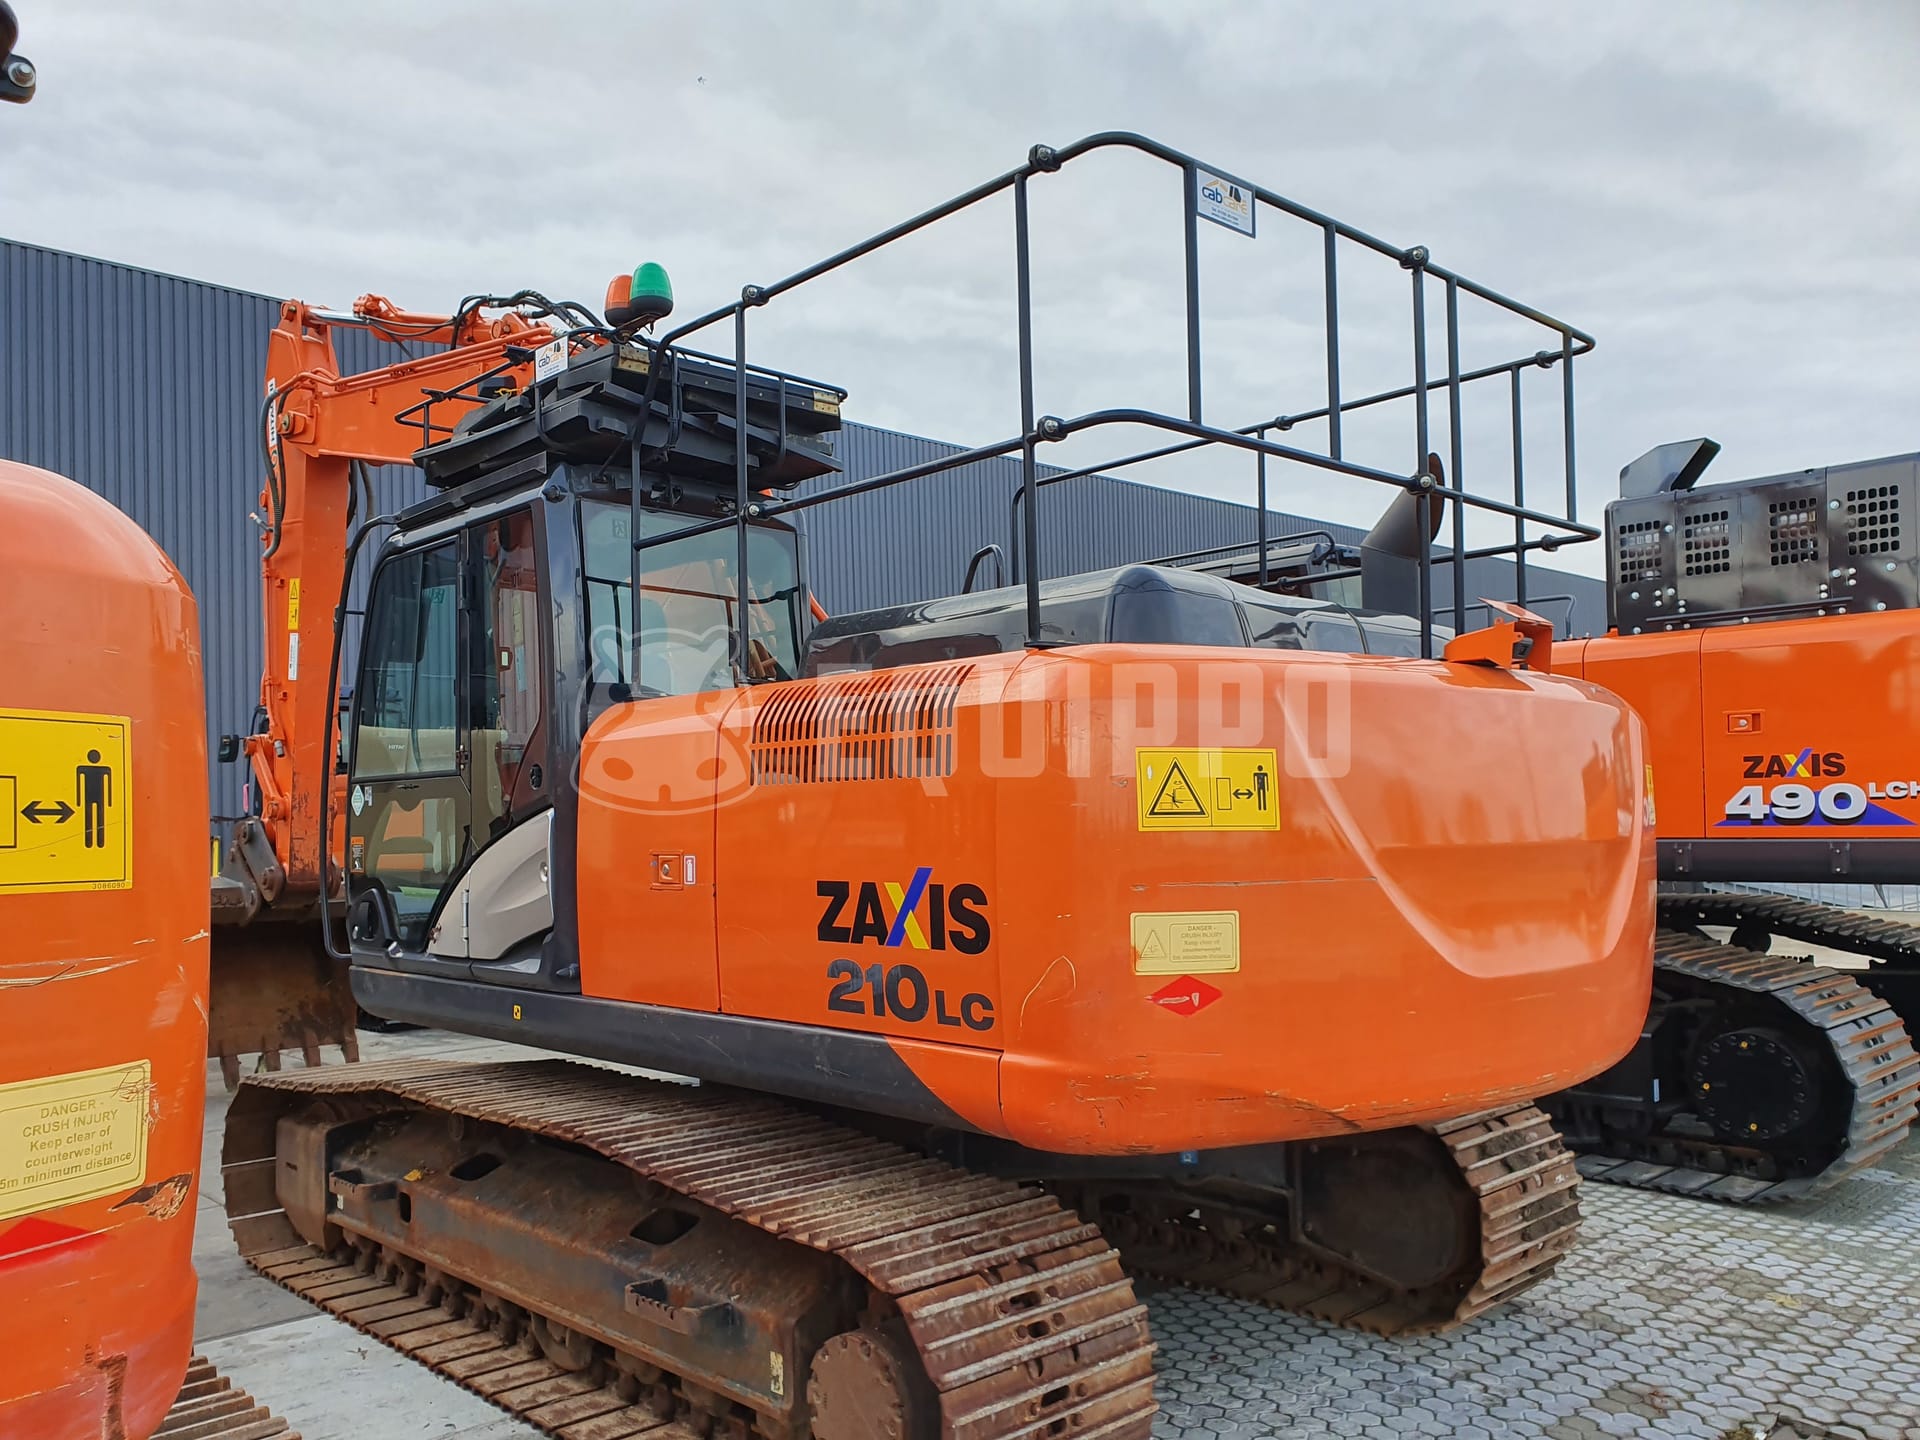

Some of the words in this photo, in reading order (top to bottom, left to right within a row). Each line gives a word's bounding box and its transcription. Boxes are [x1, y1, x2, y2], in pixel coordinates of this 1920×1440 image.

[1743, 747, 1846, 778] ZAXIS
[1725, 782, 1868, 823] 490
[816, 866, 991, 956] ZAXIS
[826, 958, 930, 1023] 210
[934, 989, 996, 1032] LC
[22, 1119, 70, 1138] CRUSH
[73, 1109, 119, 1127] INJURY
[40, 1099, 97, 1119] DANGER
[30, 1138, 63, 1152] Keep
[66, 1131, 96, 1144] clear
[99, 1125, 111, 1137] of
[23, 1164, 82, 1185] minimum
[85, 1152, 132, 1170] distance
[25, 1141, 113, 1168] counterweight
